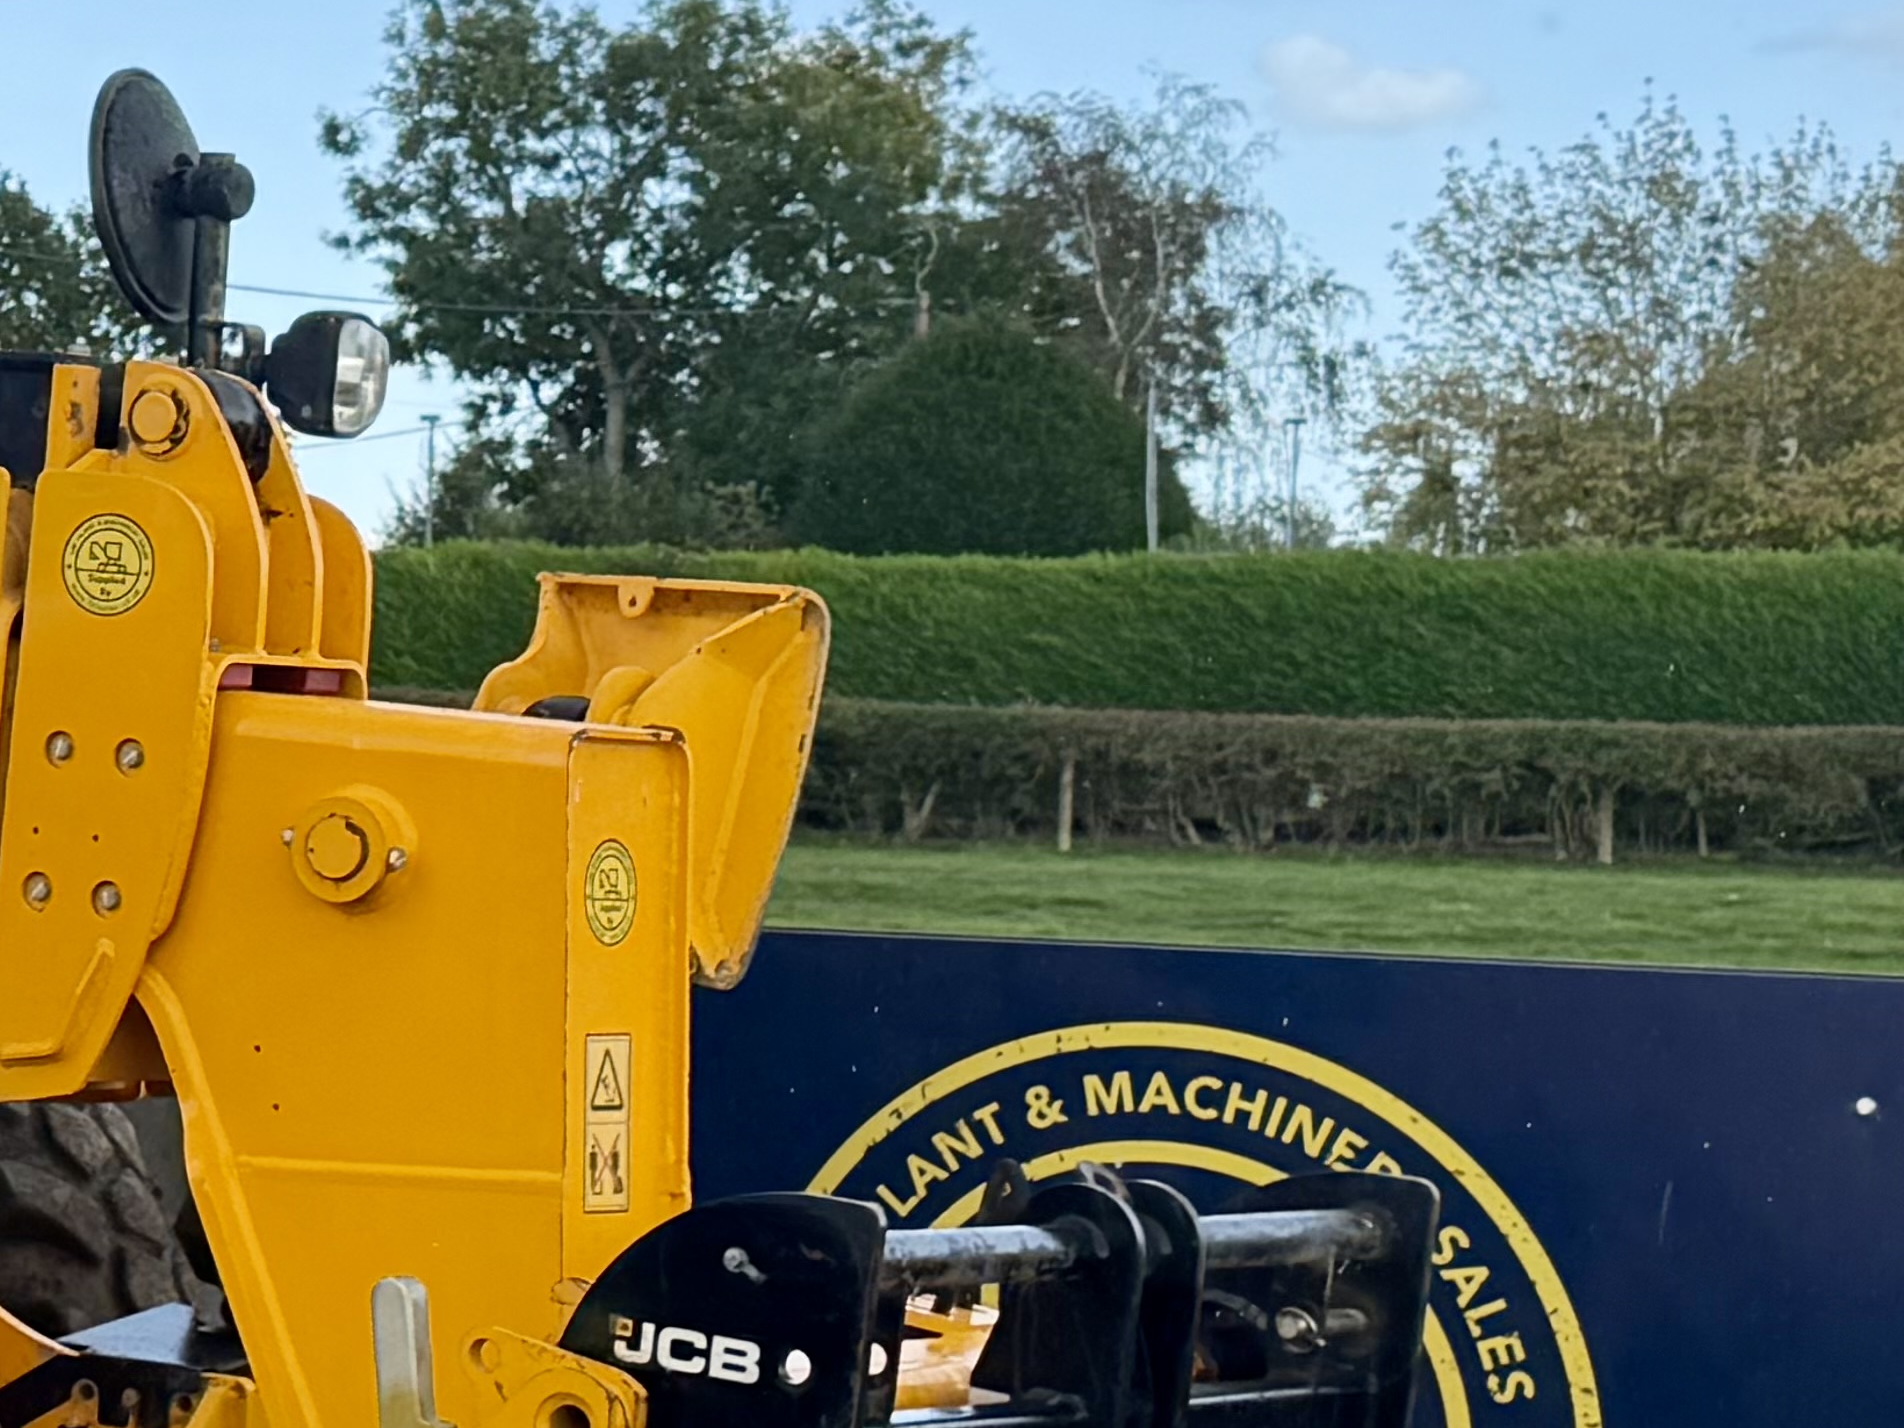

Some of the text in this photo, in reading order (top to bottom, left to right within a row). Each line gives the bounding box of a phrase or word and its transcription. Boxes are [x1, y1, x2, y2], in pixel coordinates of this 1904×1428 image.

[876, 1070, 1536, 1405] LANT & MACHINE SALES
[613, 1321, 761, 1384] JCB
